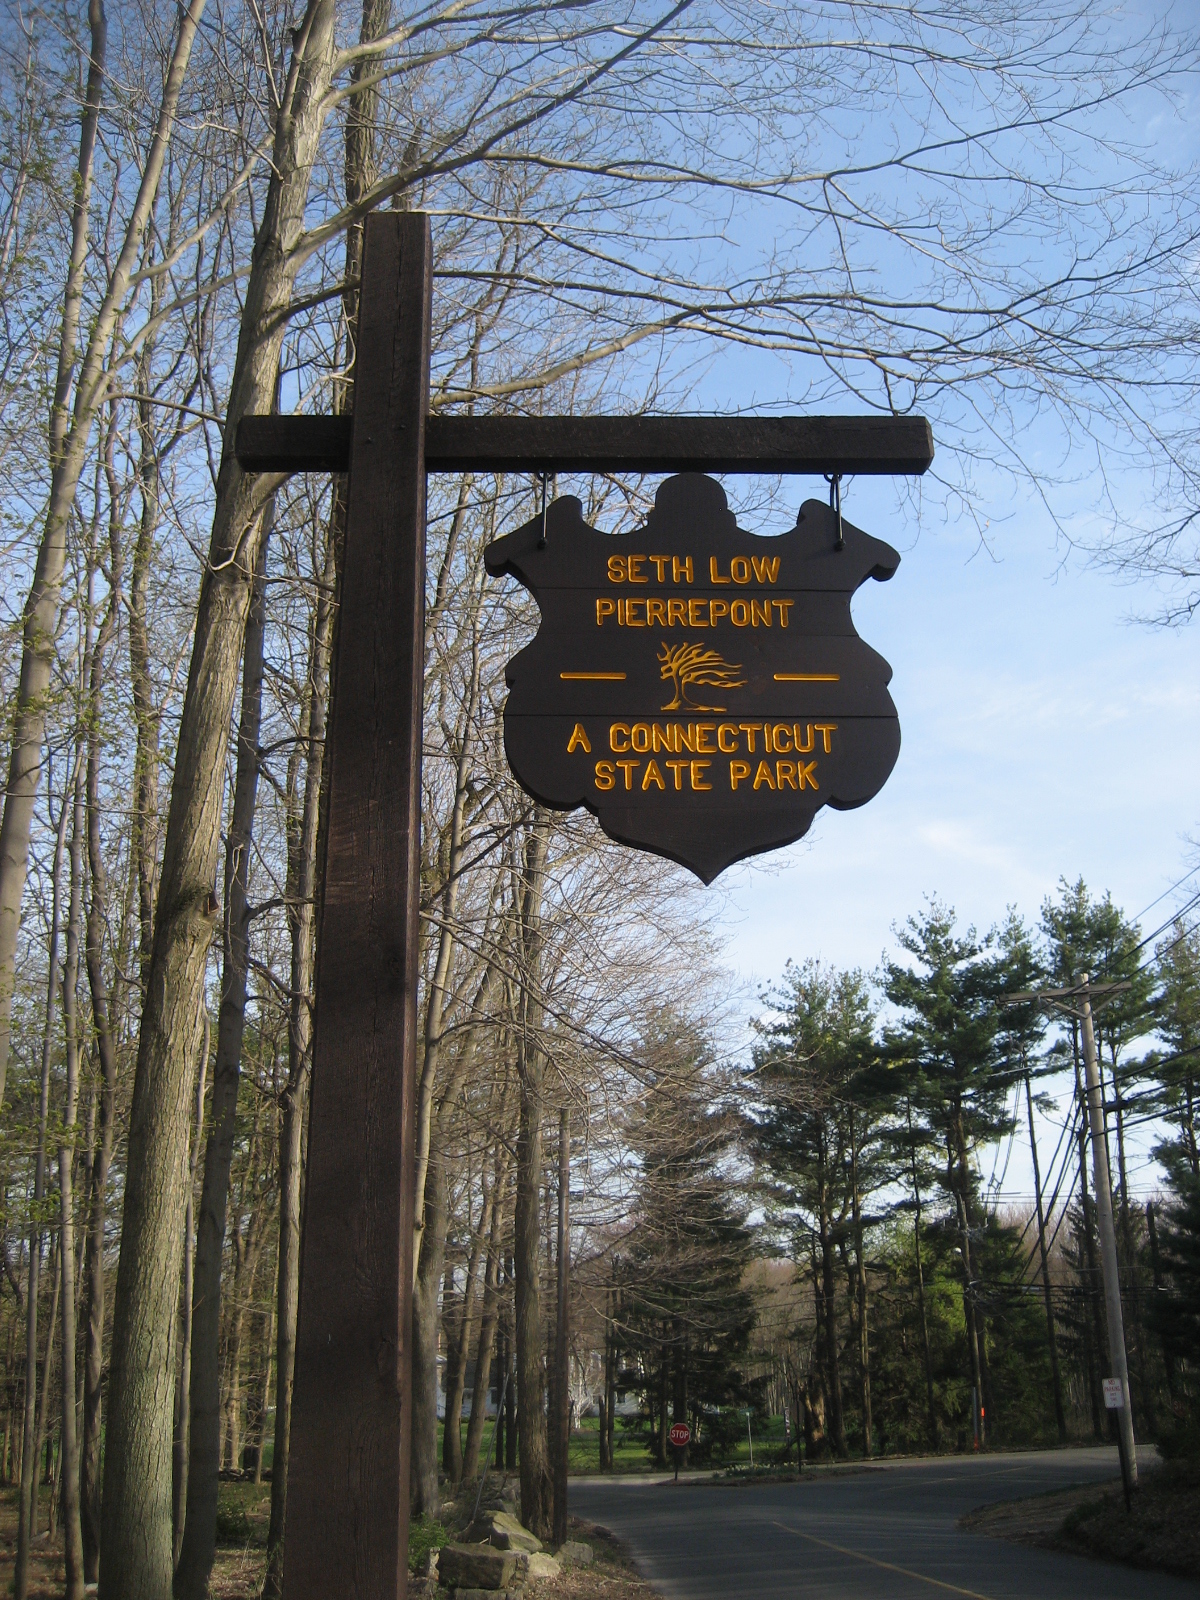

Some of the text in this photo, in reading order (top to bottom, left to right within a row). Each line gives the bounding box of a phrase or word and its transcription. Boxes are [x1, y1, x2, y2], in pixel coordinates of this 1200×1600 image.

[607, 555, 780, 584] SETH LOW
[595, 598, 794, 629] PIERREPONT
[567, 722, 837, 755] A CONNECTICUT
[595, 759, 819, 792] STATE PARK
[671, 1430, 689, 1439] STOP
